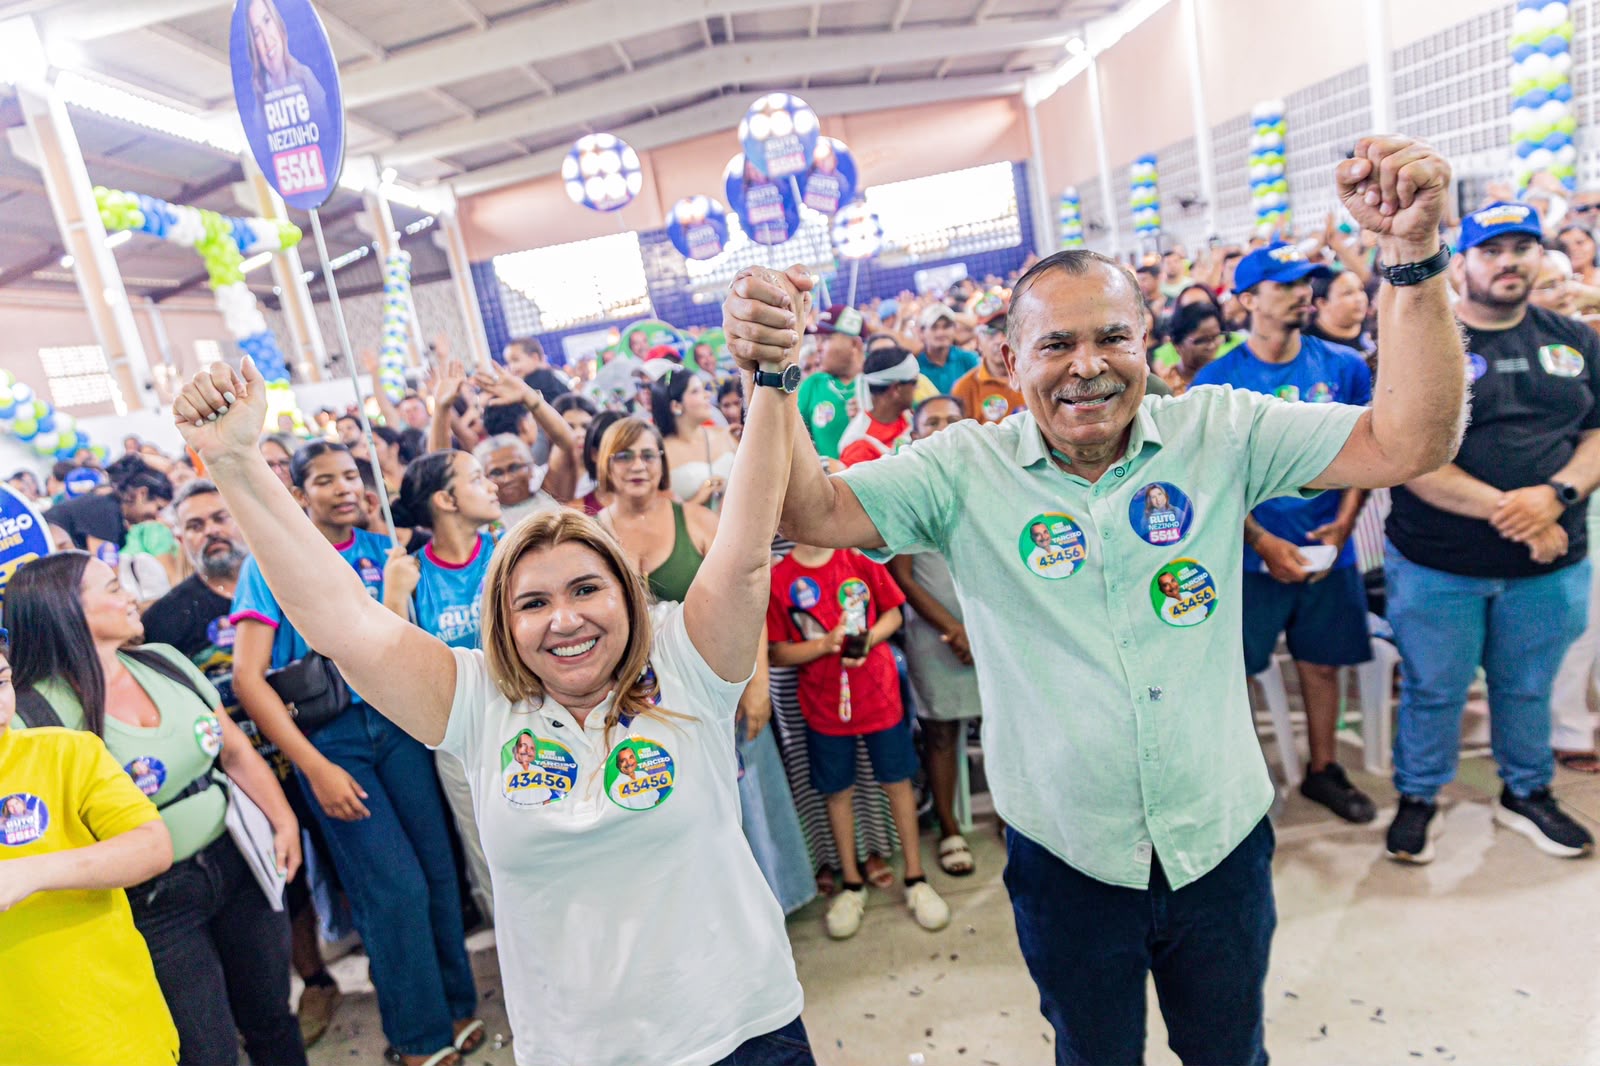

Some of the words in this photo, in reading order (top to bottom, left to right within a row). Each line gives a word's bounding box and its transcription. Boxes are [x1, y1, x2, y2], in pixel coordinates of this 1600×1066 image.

[267, 122, 320, 152] NEZINHO
[276, 150, 325, 192] 5511
[1150, 528, 1180, 542] 5511
[1040, 548, 1080, 566] 43456
[1174, 590, 1211, 615] 43456
[638, 756, 671, 769] TARCIZO
[509, 773, 566, 788] 43456
[622, 774, 668, 794] 43456
